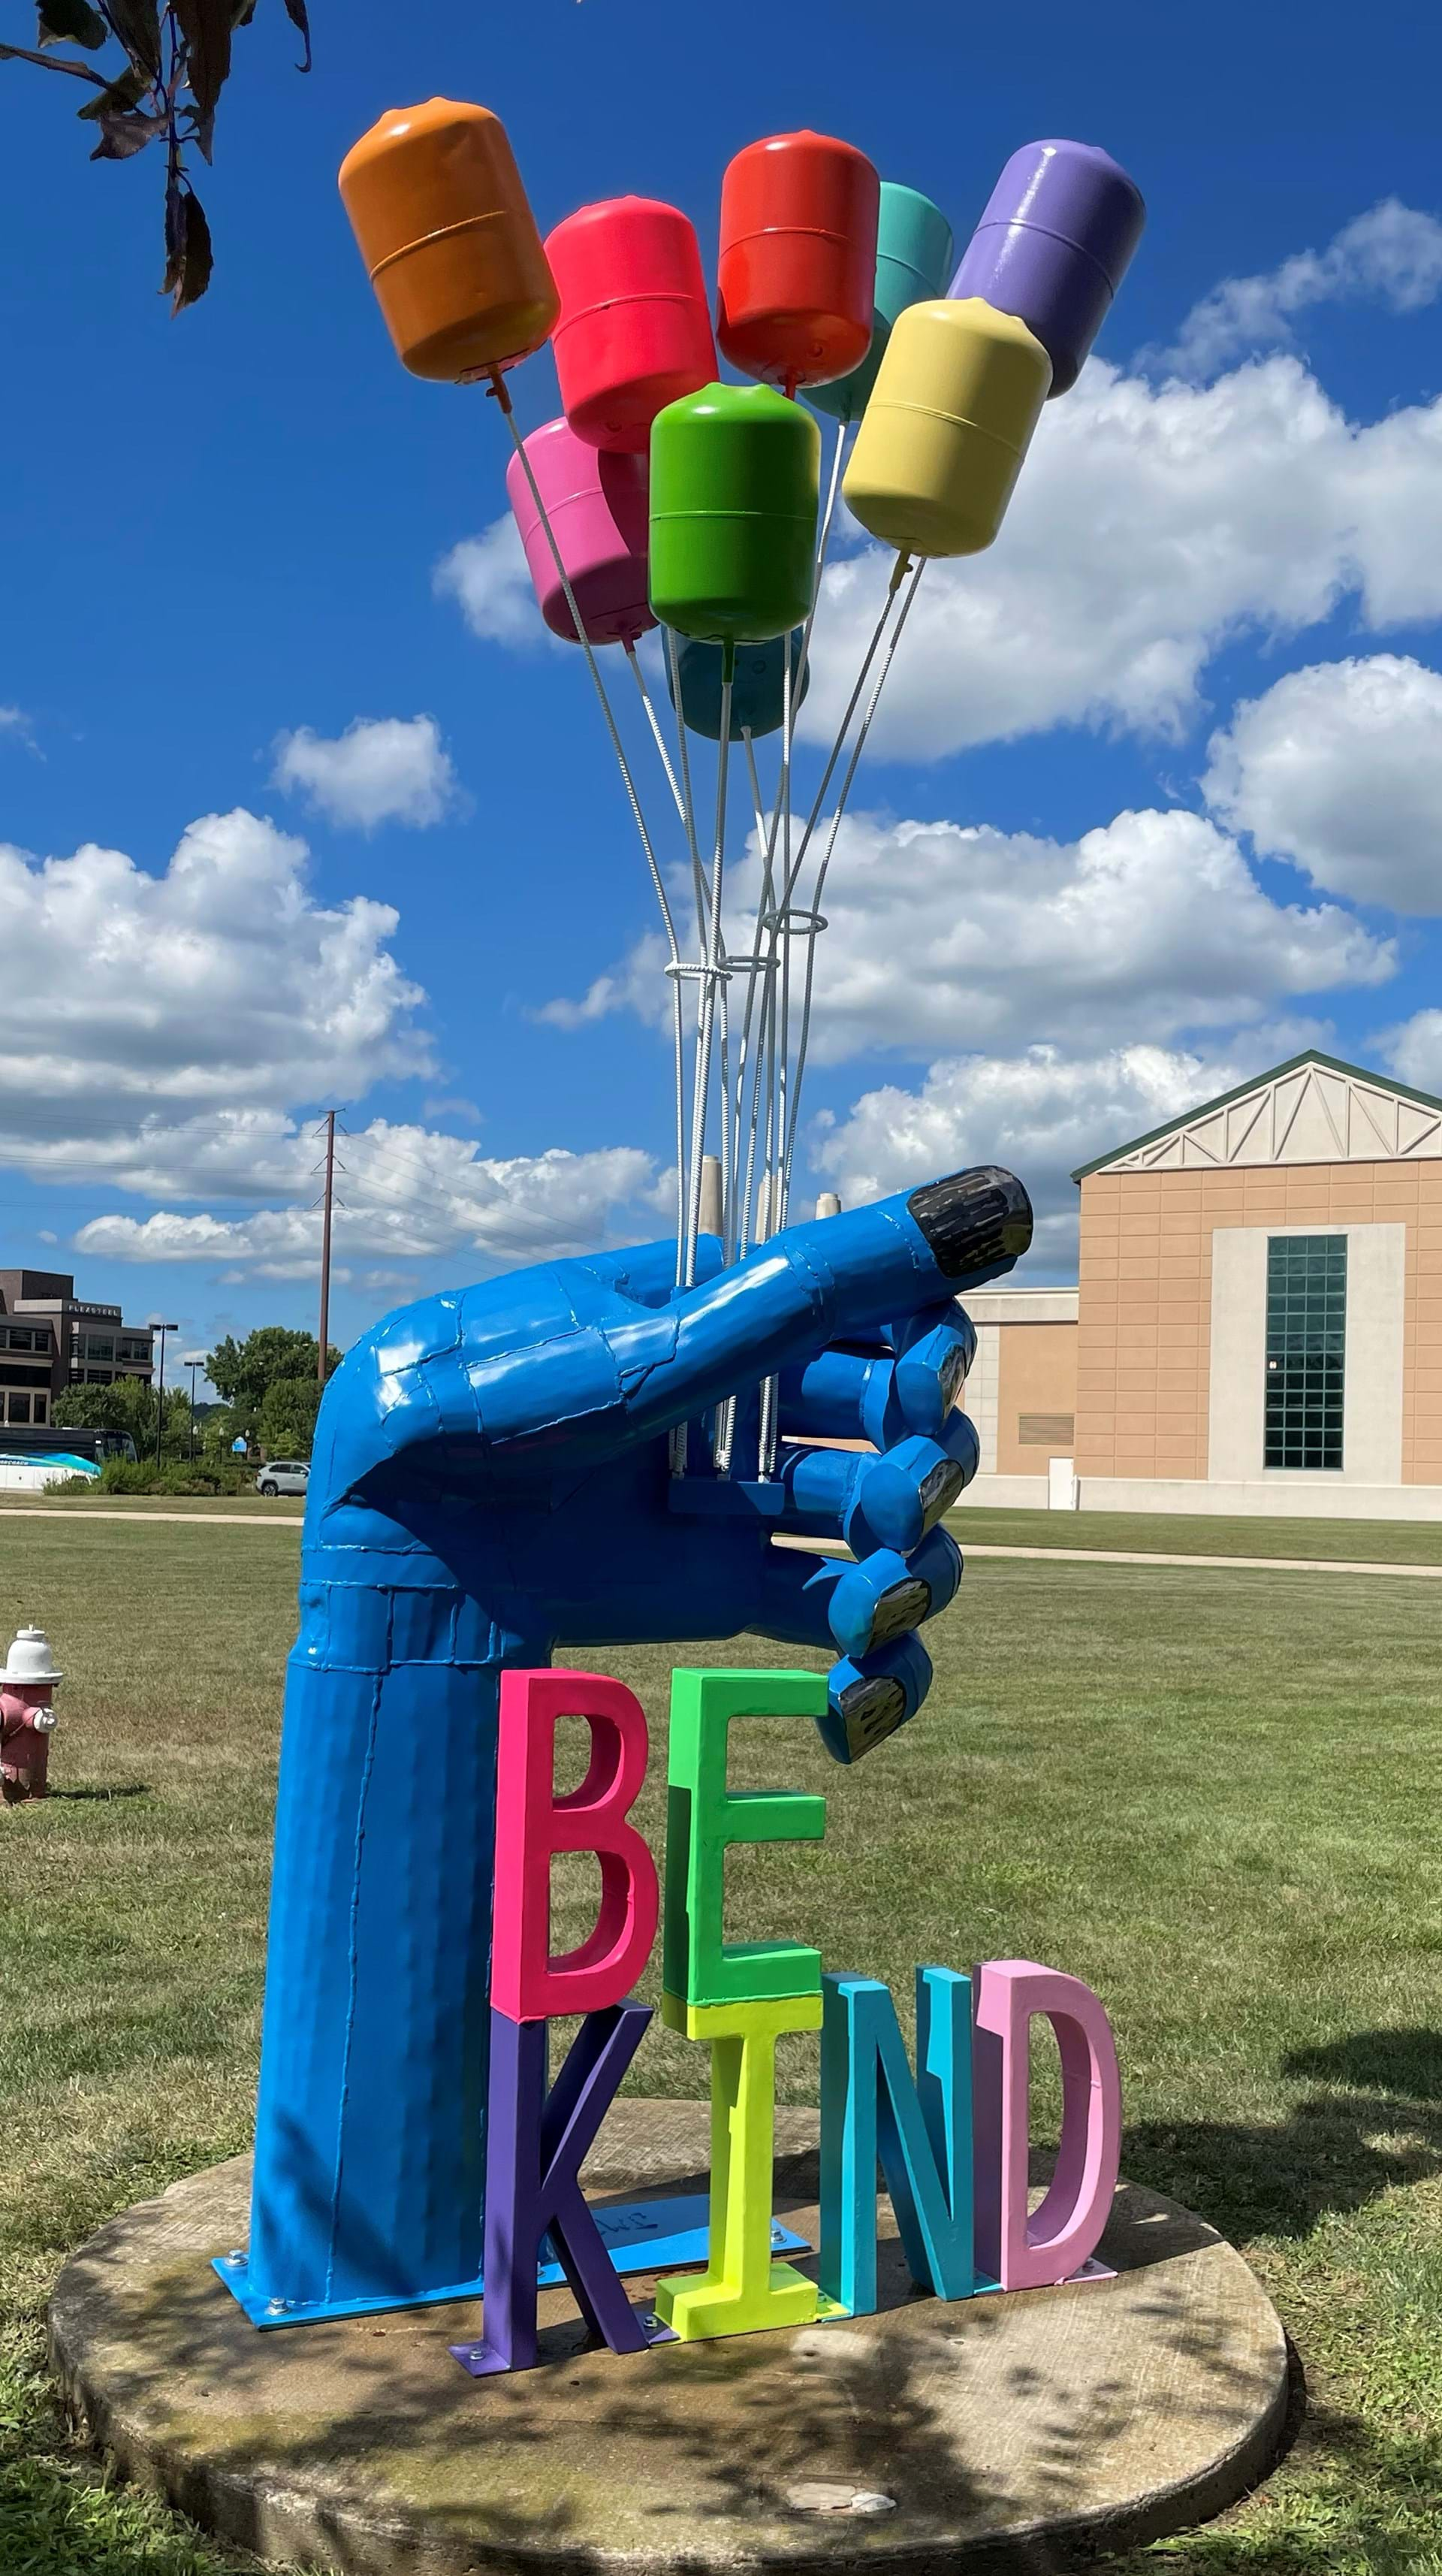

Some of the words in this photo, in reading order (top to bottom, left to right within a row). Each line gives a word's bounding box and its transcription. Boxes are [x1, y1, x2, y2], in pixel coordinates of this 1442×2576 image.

[68, 1304, 117, 1316] FLEXSTEEL
[490, 1668, 829, 2025] BE
[483, 1959, 1122, 2370] KIND
